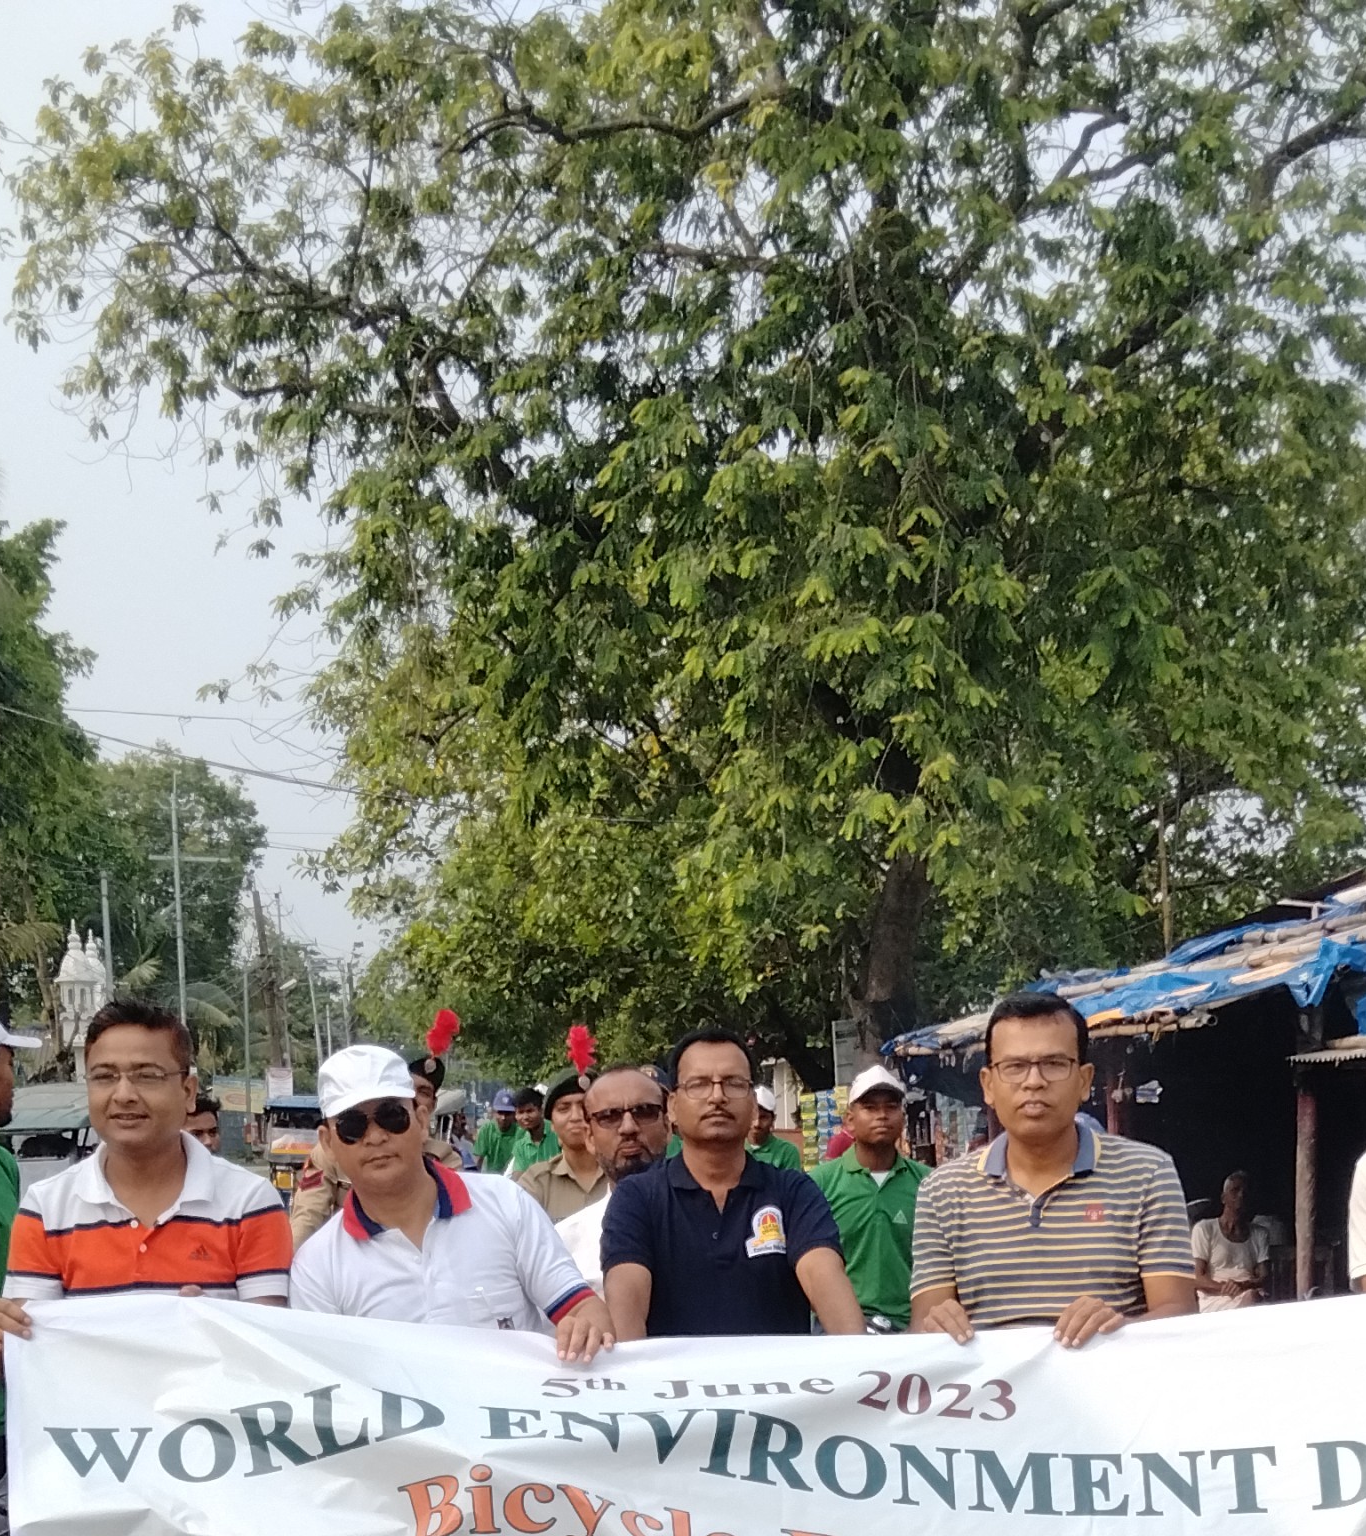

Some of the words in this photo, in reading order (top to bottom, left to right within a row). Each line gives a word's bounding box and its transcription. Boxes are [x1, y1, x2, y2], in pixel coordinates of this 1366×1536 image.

[541, 1376, 627, 1398] 5th
[657, 1373, 835, 1399] June
[856, 1370, 1017, 1422] 2023
[43, 1383, 446, 1483] WORLD
[479, 1405, 1277, 1518] ENVIRONMENT
